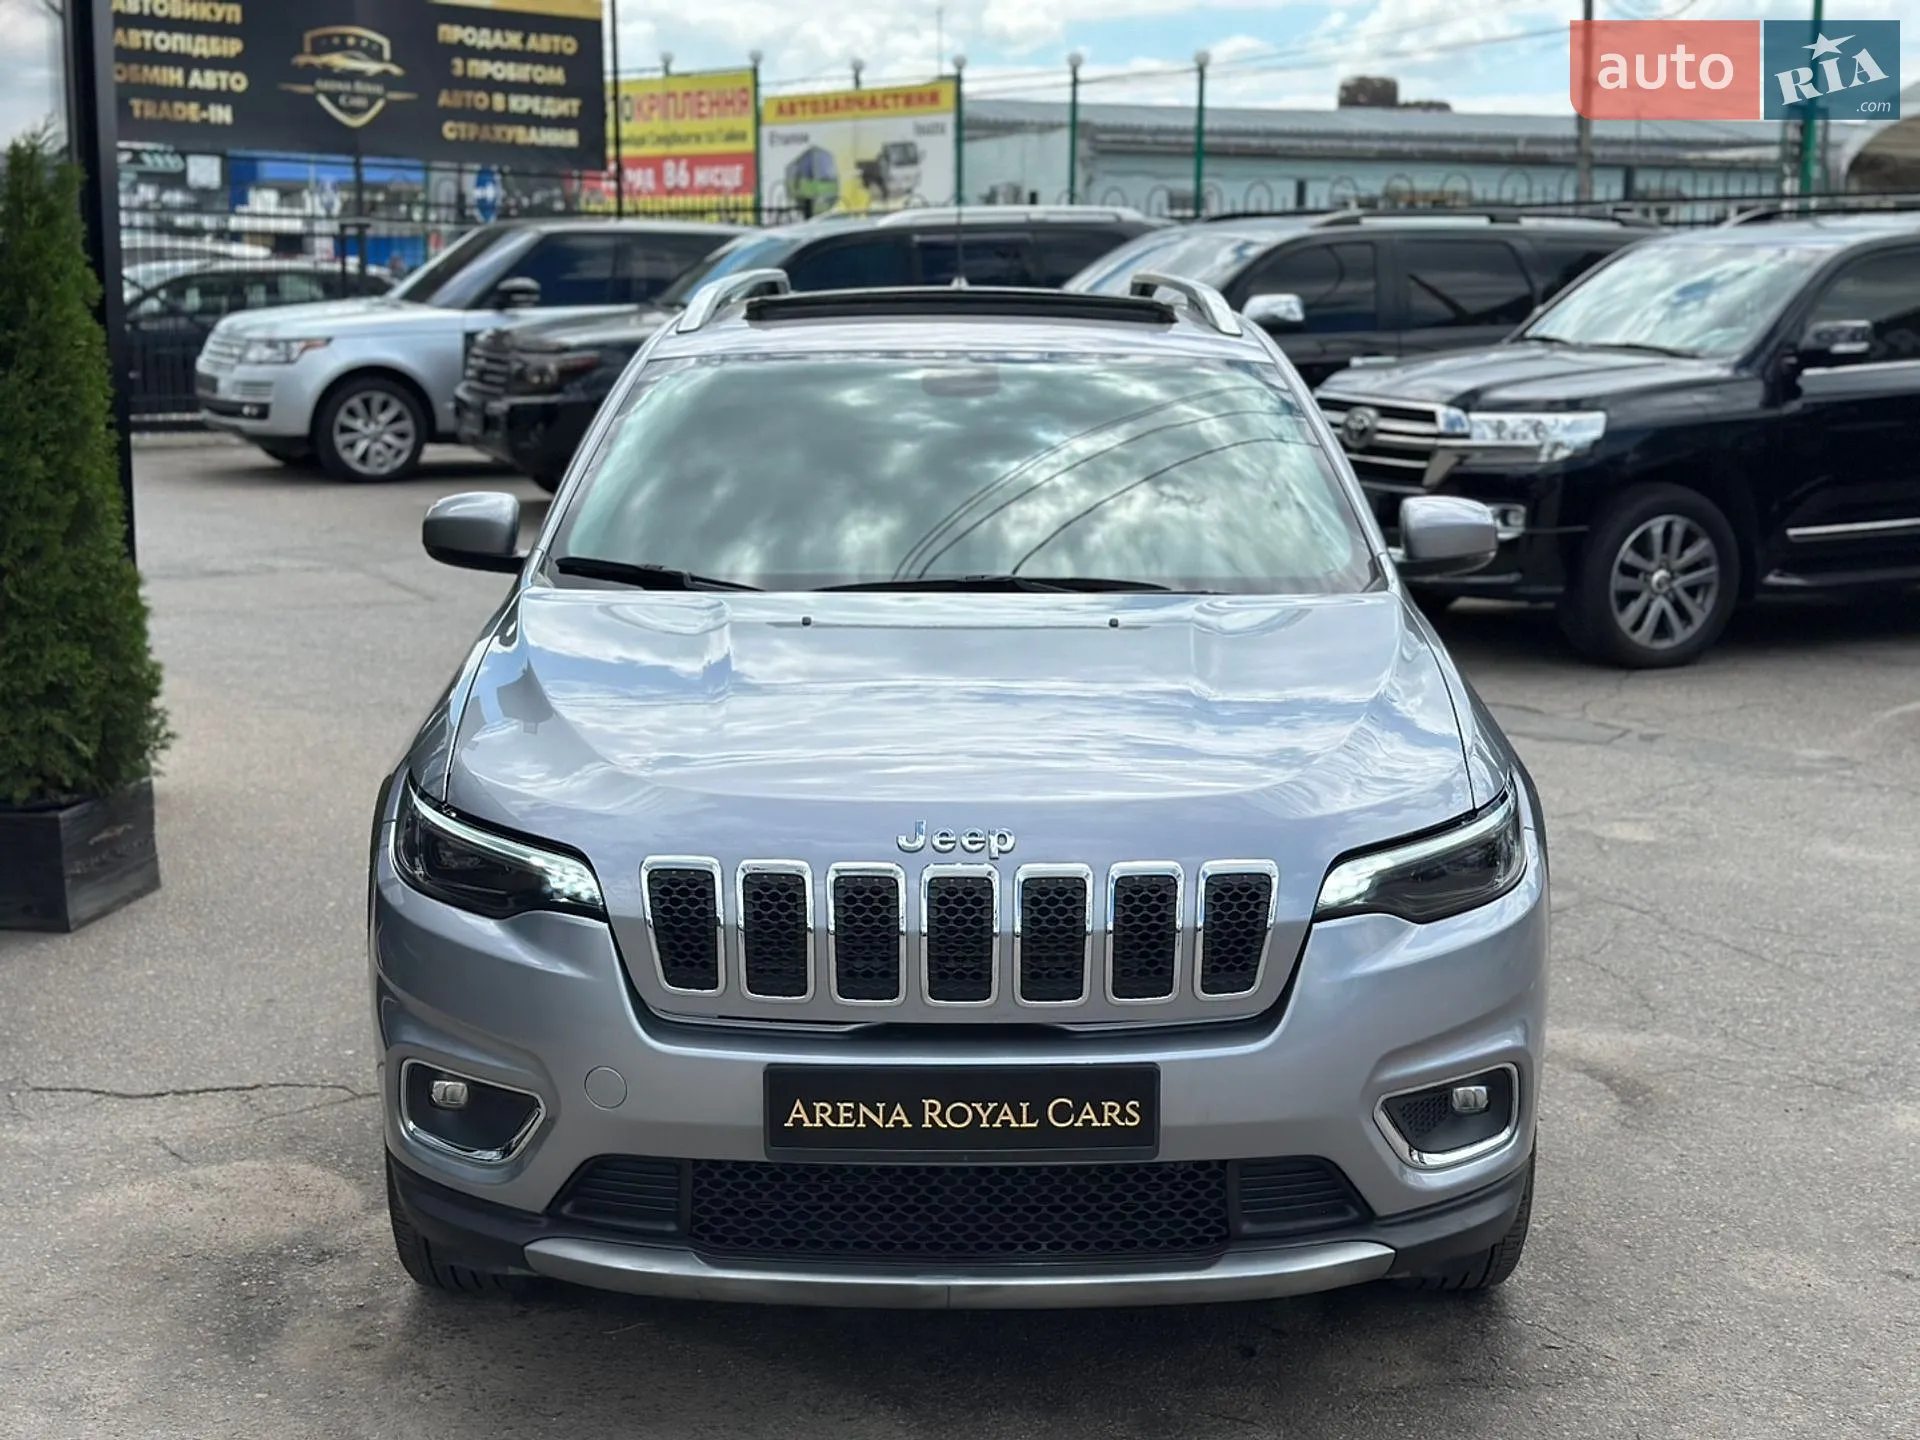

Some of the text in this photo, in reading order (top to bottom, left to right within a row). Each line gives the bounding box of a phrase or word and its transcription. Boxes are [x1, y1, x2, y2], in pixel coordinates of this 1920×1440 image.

[114, 26, 244, 59] АВТОПІДБІР
[437, 23, 579, 56] ПРОДАЖ АВТО
[113, 62, 249, 93] ОБМІН АВТО
[466, 58, 566, 86] ПРОБІГОМ
[129, 97, 233, 126] TRADE-IN
[437, 89, 582, 118] АВТО В КРЕДИТ
[776, 89, 941, 117] АВТОЗАПЧАСТИНИ
[441, 120, 579, 148] СТРАХУВАННЯ
[896, 819, 1015, 860] Jeep
[784, 1098, 1141, 1129] ARENA ROYAL CARS
